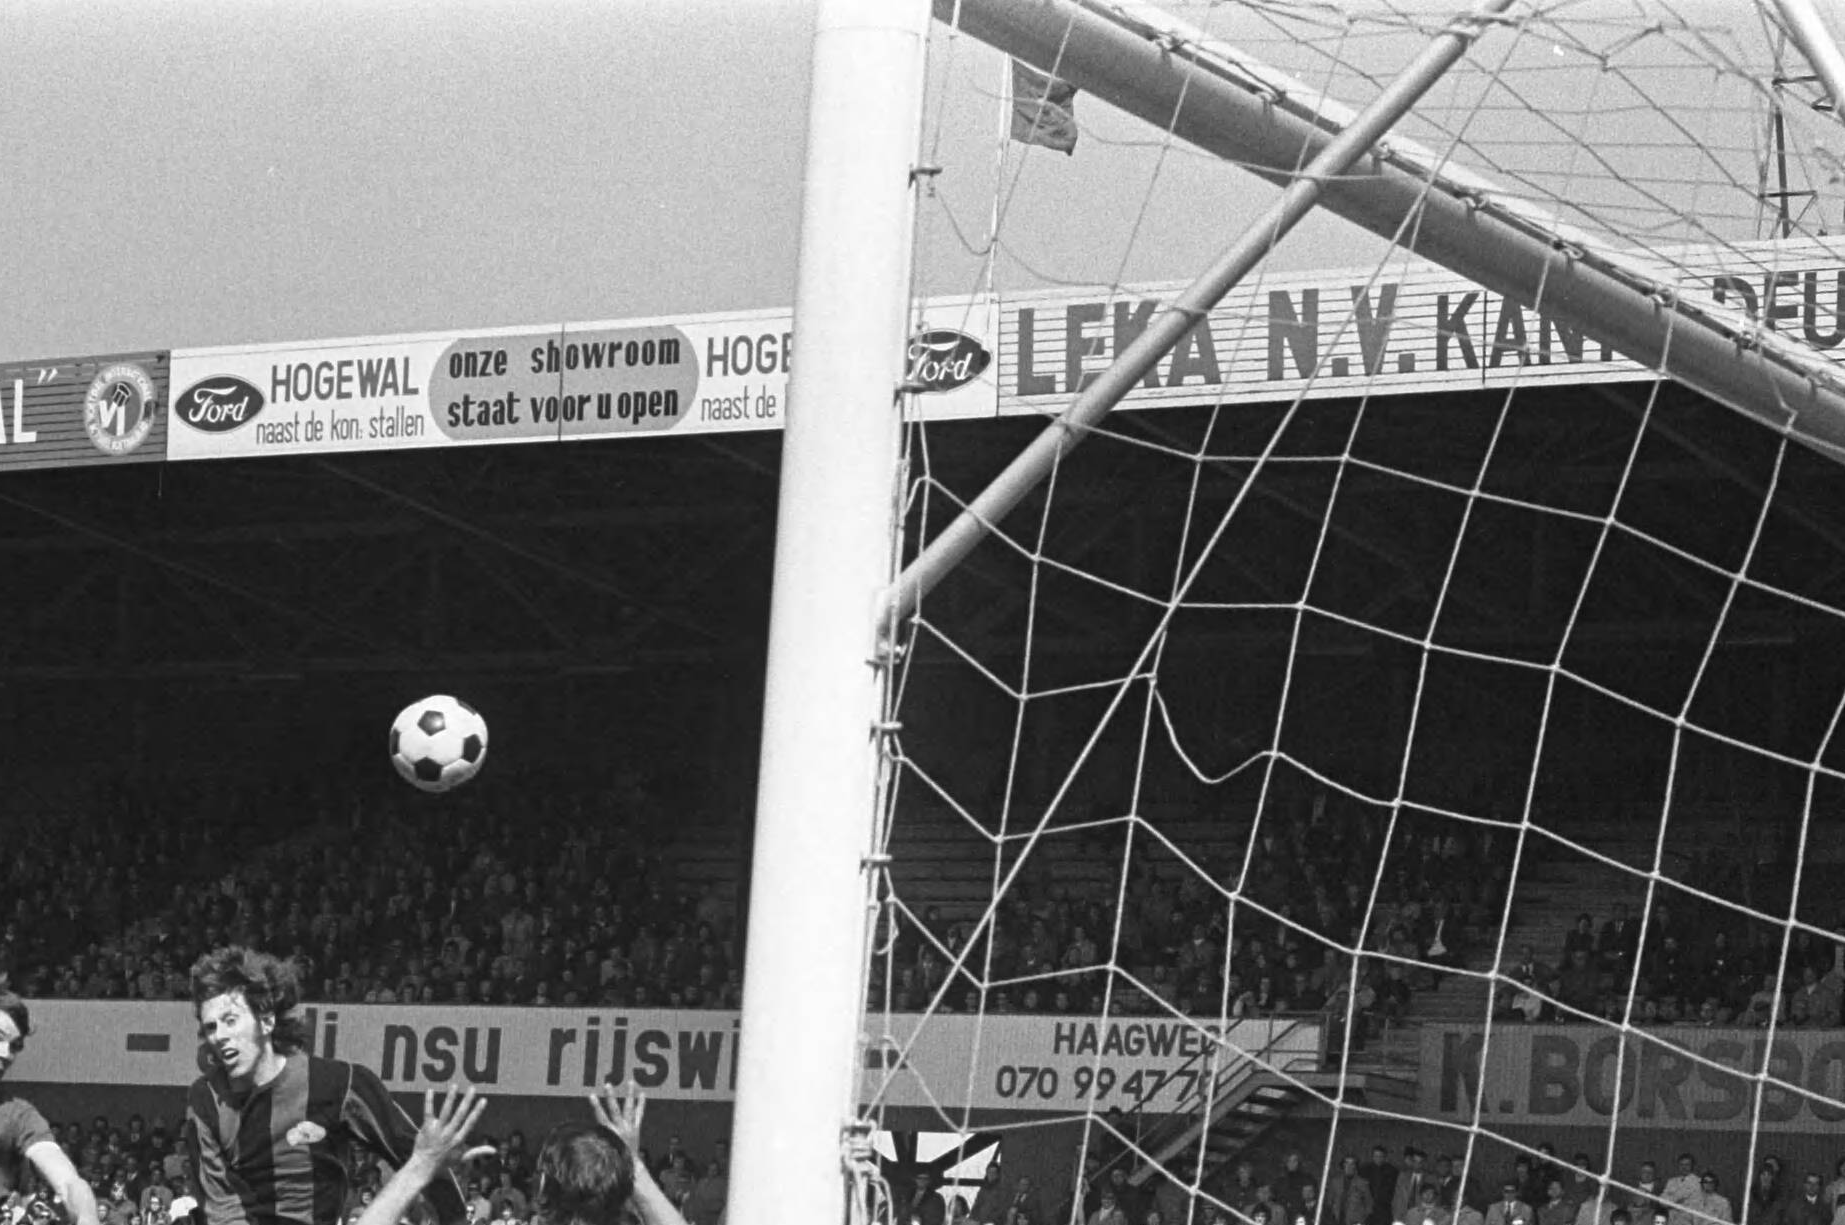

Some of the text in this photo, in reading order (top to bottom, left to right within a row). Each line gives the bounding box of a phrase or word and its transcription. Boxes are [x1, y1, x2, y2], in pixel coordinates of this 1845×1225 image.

[449, 335, 680, 378] onze showroom
[271, 356, 419, 404] HOGEWAL
[188, 385, 249, 424] Ford
[447, 387, 678, 428] staat voor u open
[701, 384, 776, 422] naast de
[256, 411, 300, 444] naast
[304, 410, 323, 442] de
[369, 406, 424, 439] stallen
[381, 1023, 501, 1083] nsu
[546, 1015, 742, 1091] rijswi
[995, 1065, 1058, 1099] 070
